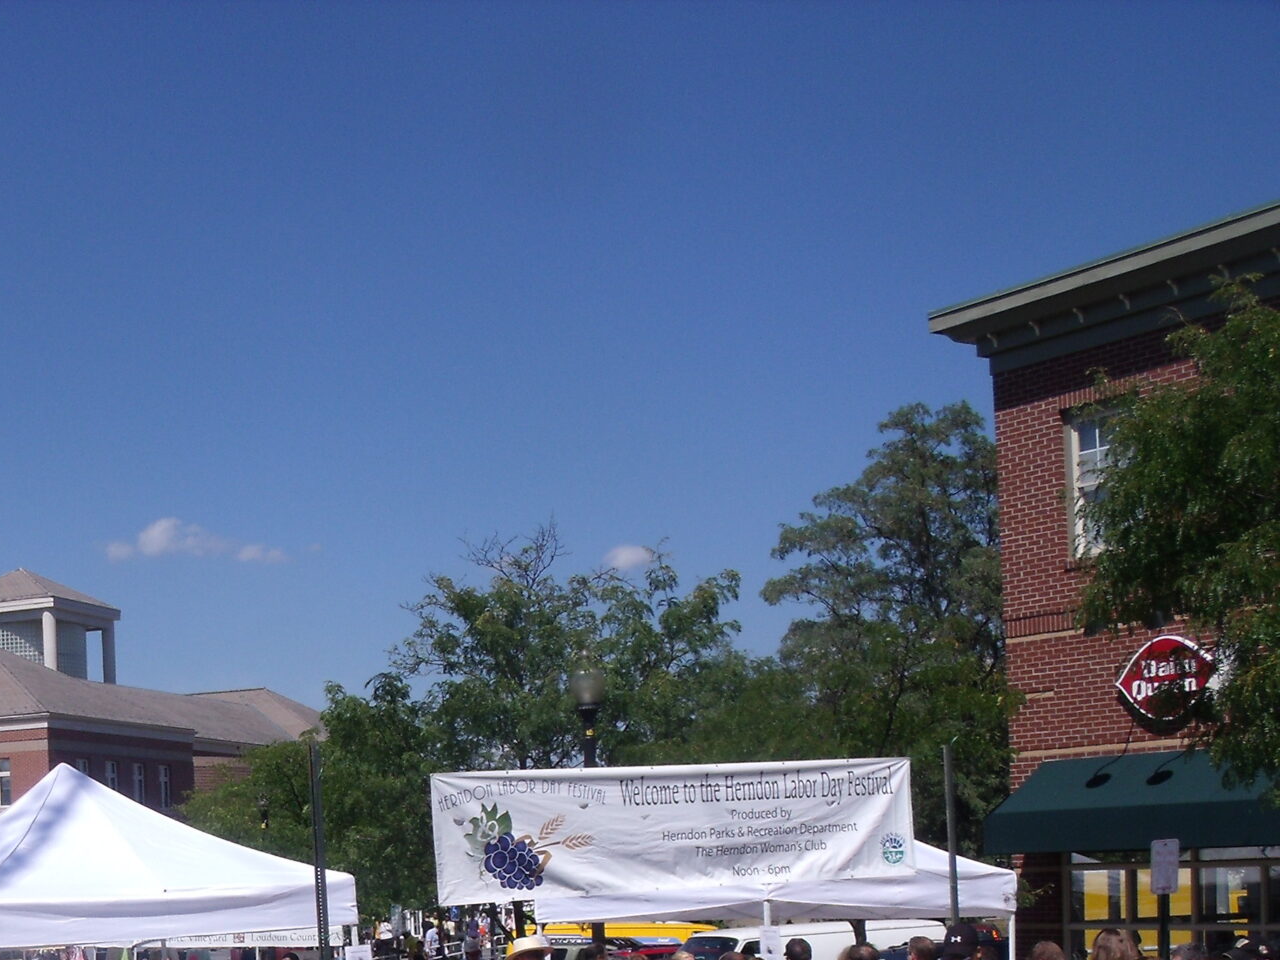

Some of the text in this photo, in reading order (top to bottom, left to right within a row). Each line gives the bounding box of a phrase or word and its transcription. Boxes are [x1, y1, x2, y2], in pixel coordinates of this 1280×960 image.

[1141, 655, 1198, 678] Daiy
[1132, 677, 1198, 701] Qun
[438, 779, 607, 812] HERNDON LABOR DAY FESTIVAL
[620, 766, 894, 806] Welcome to the Herndon Labor Day Festival
[731, 807, 792, 821] Produced by
[662, 822, 858, 841] Herndon Parks & Recreation Department
[696, 839, 827, 857] The Herndon Woman's Club
[732, 865, 759, 877] Noon
[767, 864, 791, 876] 6pm
[251, 933, 288, 942] Loudoun
[290, 932, 317, 942] Count
